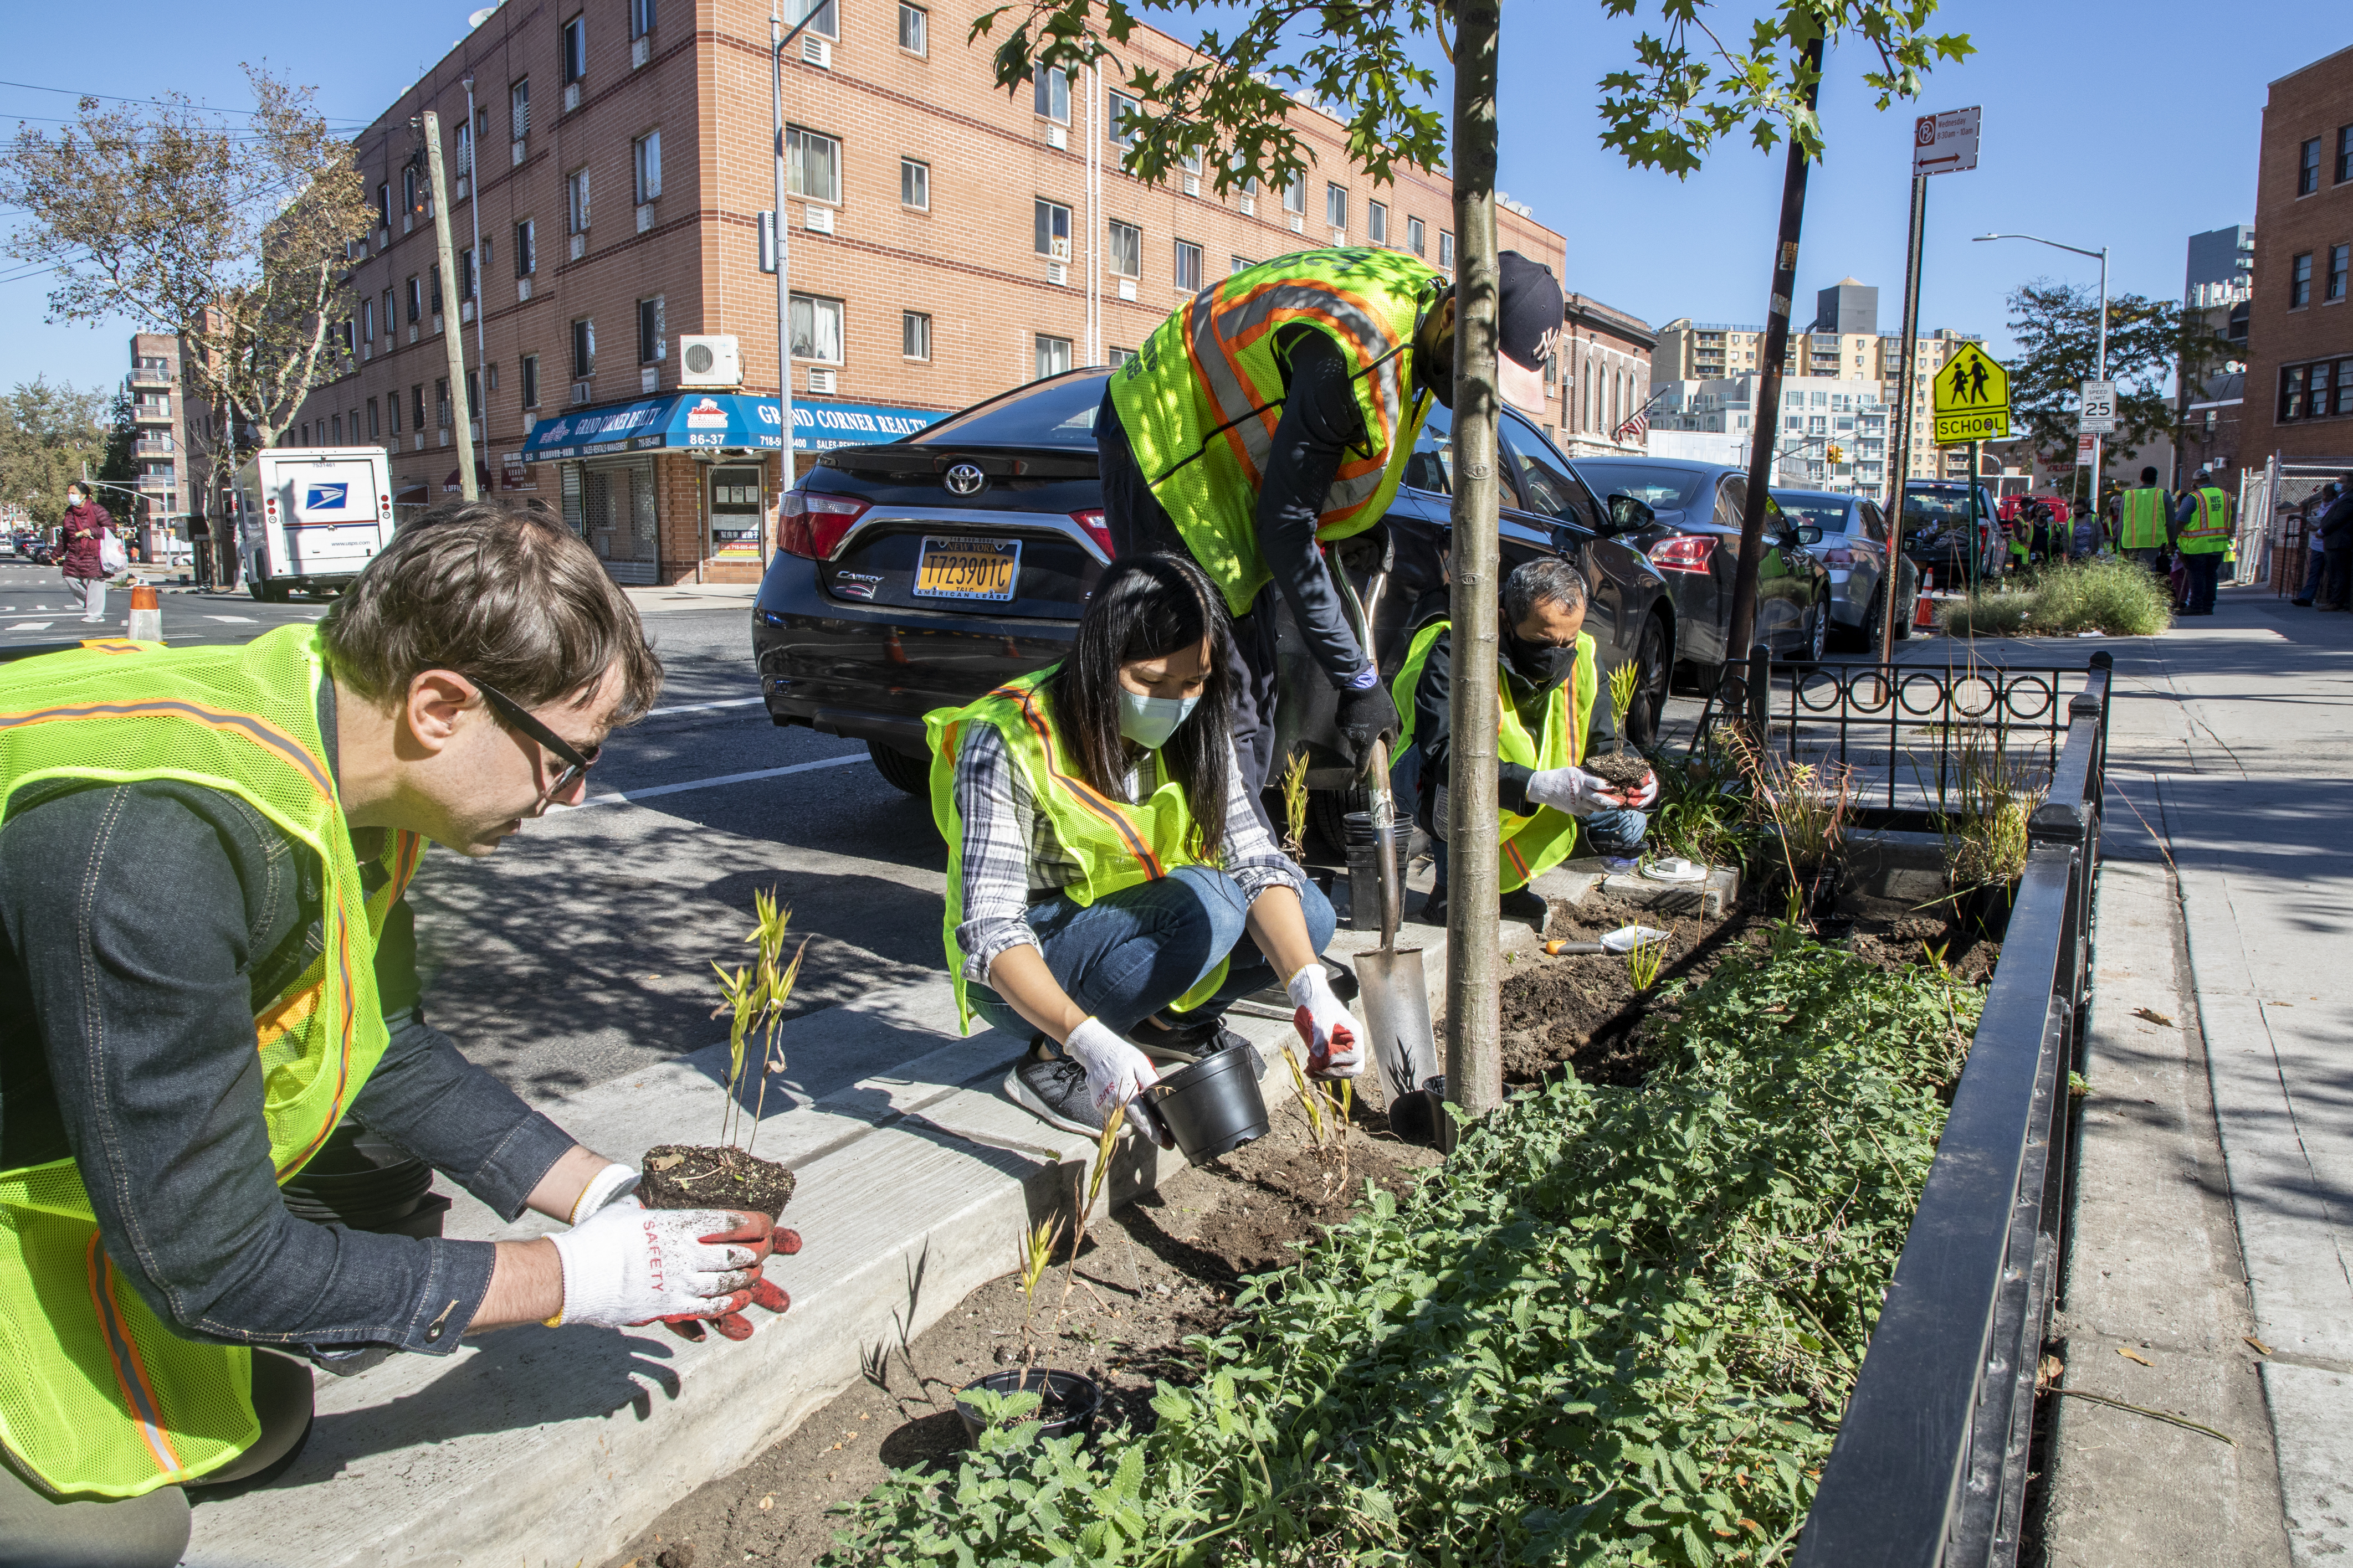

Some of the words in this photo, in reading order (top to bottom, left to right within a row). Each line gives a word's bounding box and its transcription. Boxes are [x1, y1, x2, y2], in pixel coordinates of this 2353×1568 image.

[1938, 117, 1966, 128] Wednesday
[1937, 131, 1956, 140] 8:30am
[1960, 128, 1973, 136] 10am
[2085, 402, 2110, 416] 25
[575, 417, 602, 436] GRAND
[599, 412, 630, 433] CORNER
[626, 407, 662, 429] REALTY
[758, 405, 814, 426] GRND
[816, 410, 878, 432] CORNER
[876, 415, 927, 435] REALTY
[1940, 417, 2004, 435] SCHOOL
[690, 434, 725, 445] 86-37
[2211, 503, 2221, 512] DEP
[946, 542, 970, 551] NEW
[972, 544, 997, 553] YORK
[836, 570, 884, 584] CAMRY
[928, 555, 1008, 587] T723901C
[1095, 1081, 1115, 1109] SAFETY
[643, 1220, 664, 1292] SAFETY
